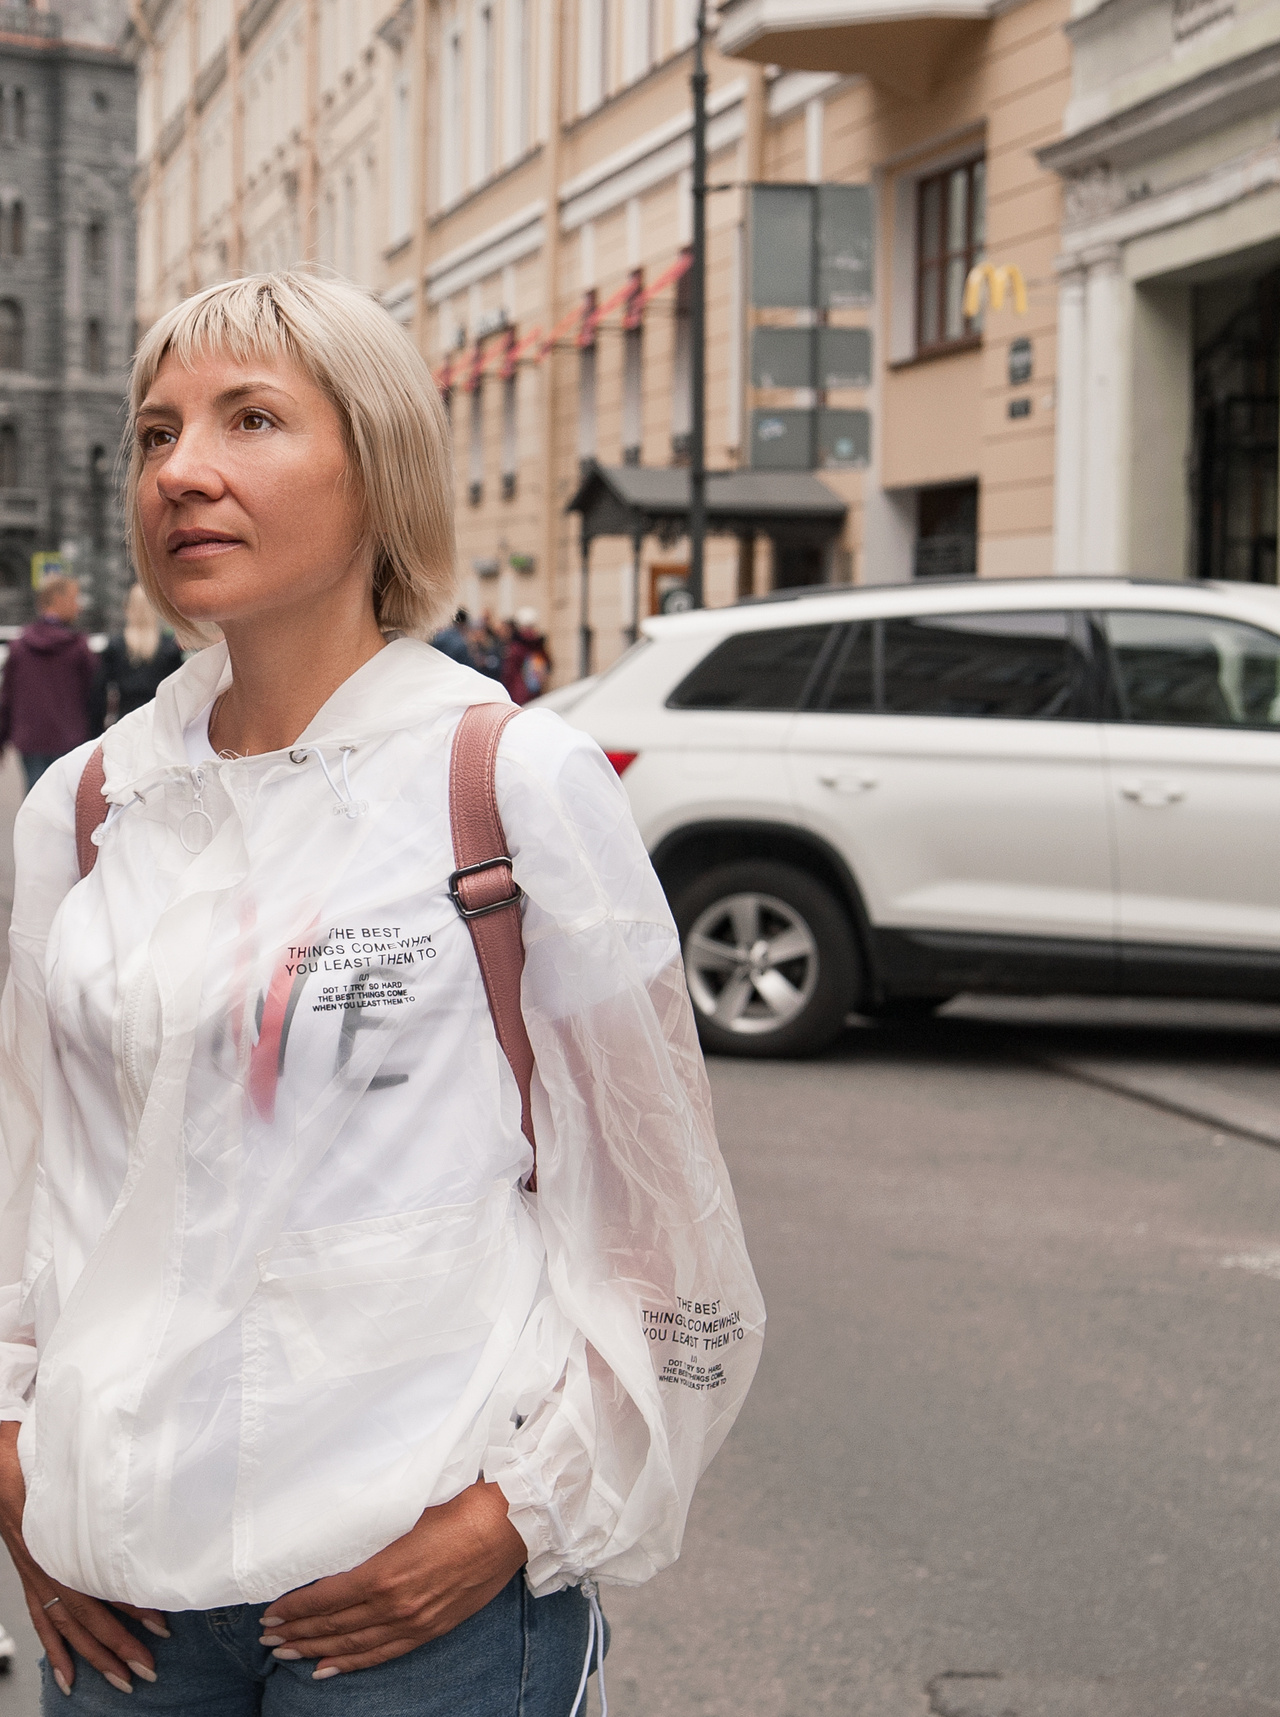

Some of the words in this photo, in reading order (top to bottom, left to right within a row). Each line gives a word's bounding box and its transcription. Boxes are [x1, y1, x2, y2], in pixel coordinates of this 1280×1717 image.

[328, 927, 356, 940] THE
[361, 927, 401, 939] BEST
[287, 944, 345, 959] THINGS
[285, 961, 318, 976] YOU
[324, 956, 372, 971] LEAST
[377, 952, 415, 966] THEM
[416, 947, 437, 961] TO
[350, 983, 365, 992] TRY
[368, 982, 379, 990] SO
[381, 981, 403, 989] HARD
[317, 995, 334, 1003] THE
[335, 992, 355, 1002] BEST
[357, 990, 385, 999] THINGS
[386, 988, 408, 997] COME
[312, 1003, 337, 1013] WHEN
[338, 1001, 356, 1010] YOU
[356, 999, 380, 1008] LEAST
[382, 998, 403, 1006] THEM
[676, 1296, 693, 1313] THE
[694, 1299, 721, 1315] BEST
[642, 1327, 667, 1341] YOU
[671, 1330, 699, 1349] LEAST
[703, 1332, 730, 1350] THEM
[732, 1327, 744, 1341] TO
[662, 1366, 678, 1375] THE
[695, 1366, 706, 1375] SO
[658, 1375, 679, 1384] WHEN
